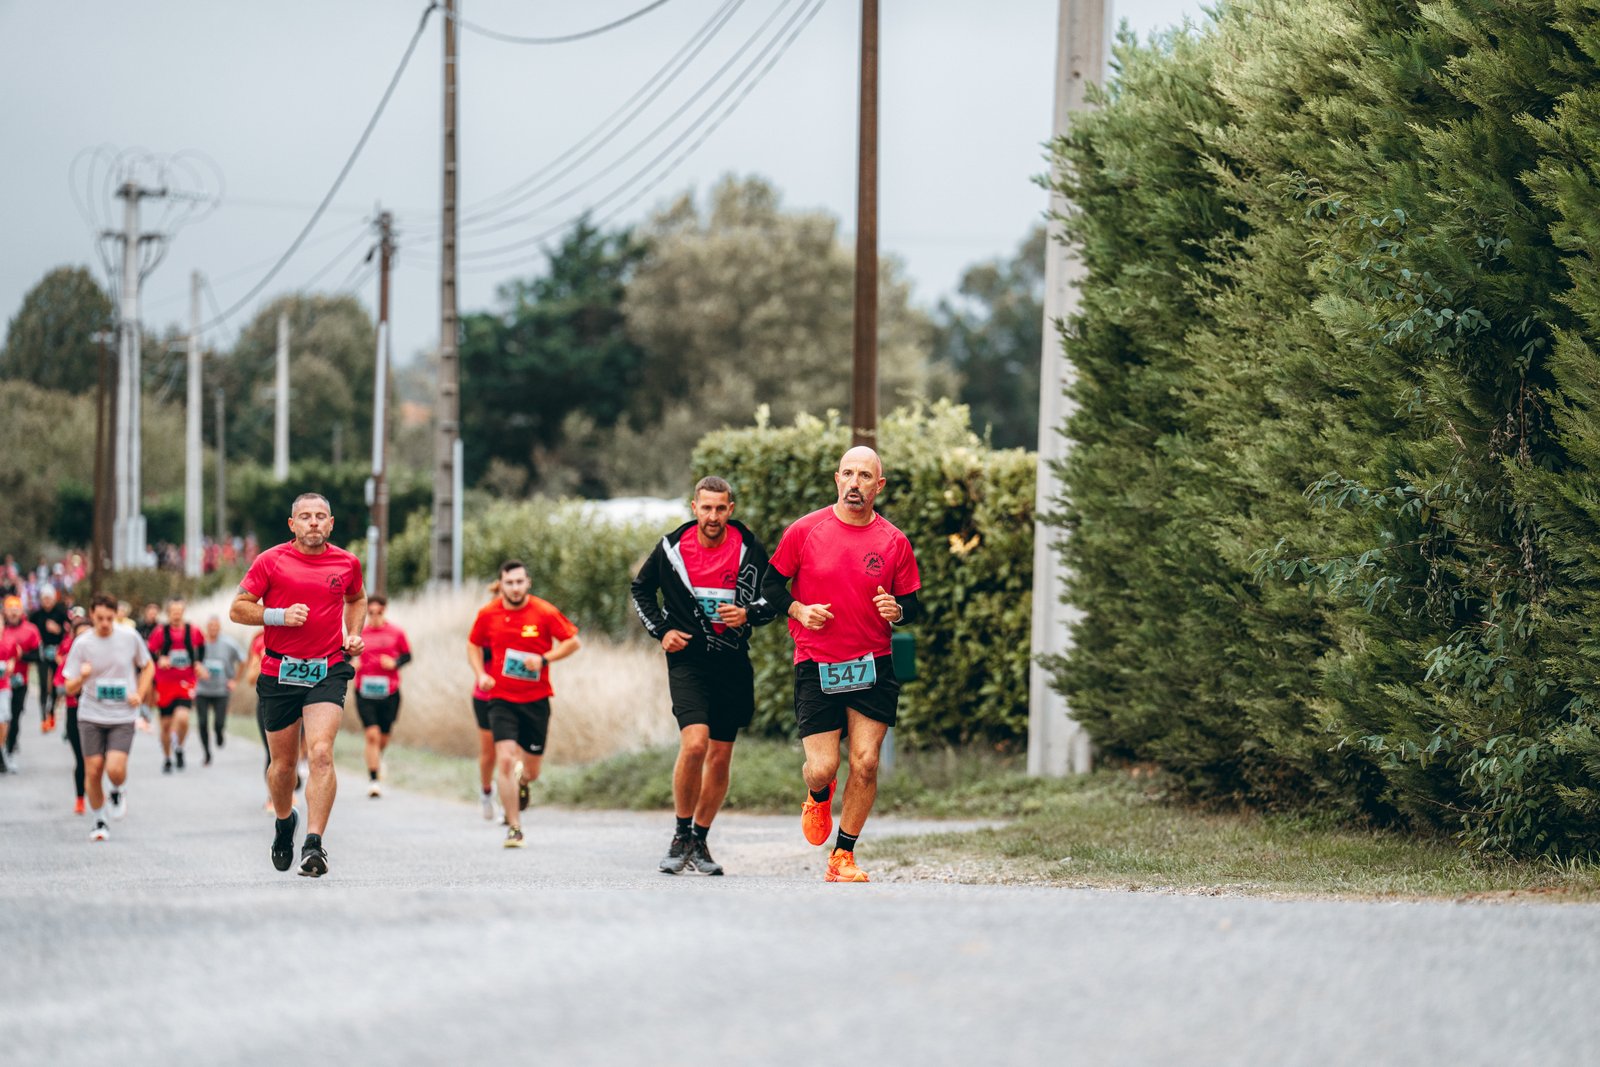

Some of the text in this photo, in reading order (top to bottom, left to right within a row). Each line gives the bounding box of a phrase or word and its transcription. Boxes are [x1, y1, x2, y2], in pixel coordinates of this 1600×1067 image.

[698, 599, 729, 615] 53
[285, 662, 322, 680] 294
[827, 663, 868, 685] 547
